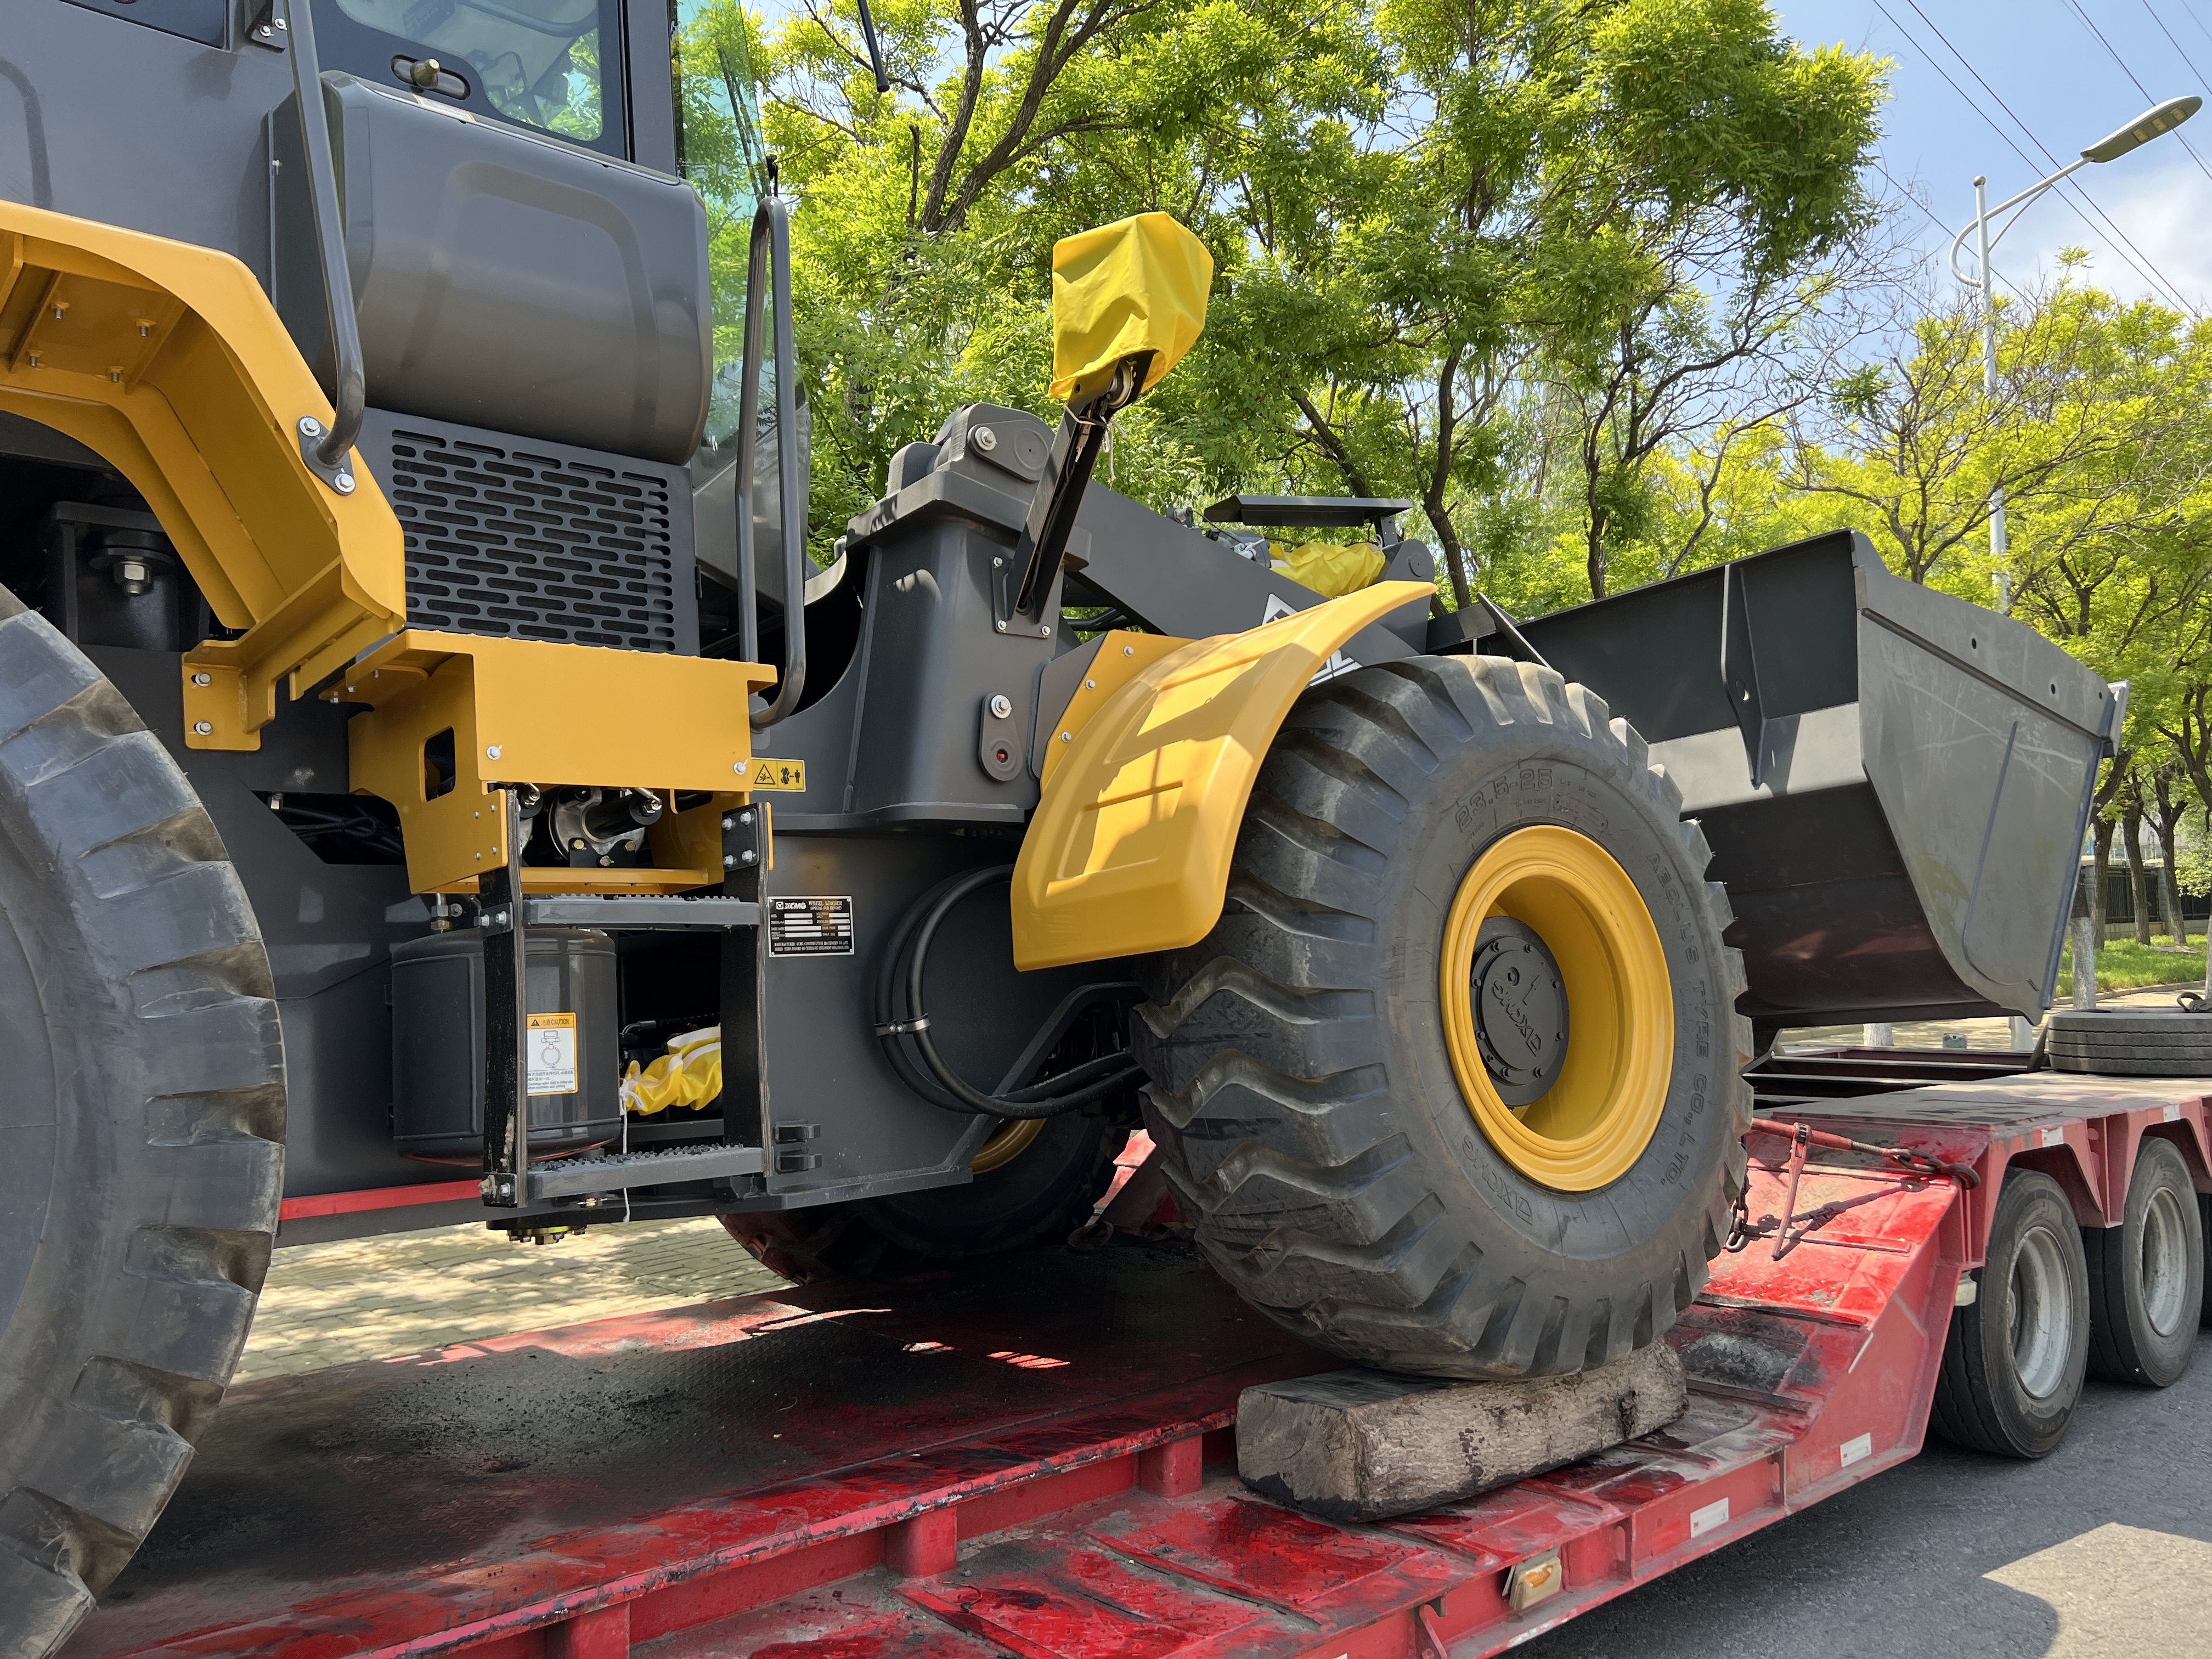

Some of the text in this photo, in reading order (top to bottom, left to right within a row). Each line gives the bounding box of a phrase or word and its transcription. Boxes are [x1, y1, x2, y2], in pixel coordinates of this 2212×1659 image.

[1455, 768, 1553, 833] 23.5-25
[1646, 853, 1699, 964] AEOLUS
[1491, 980, 1532, 1039] XCMG
